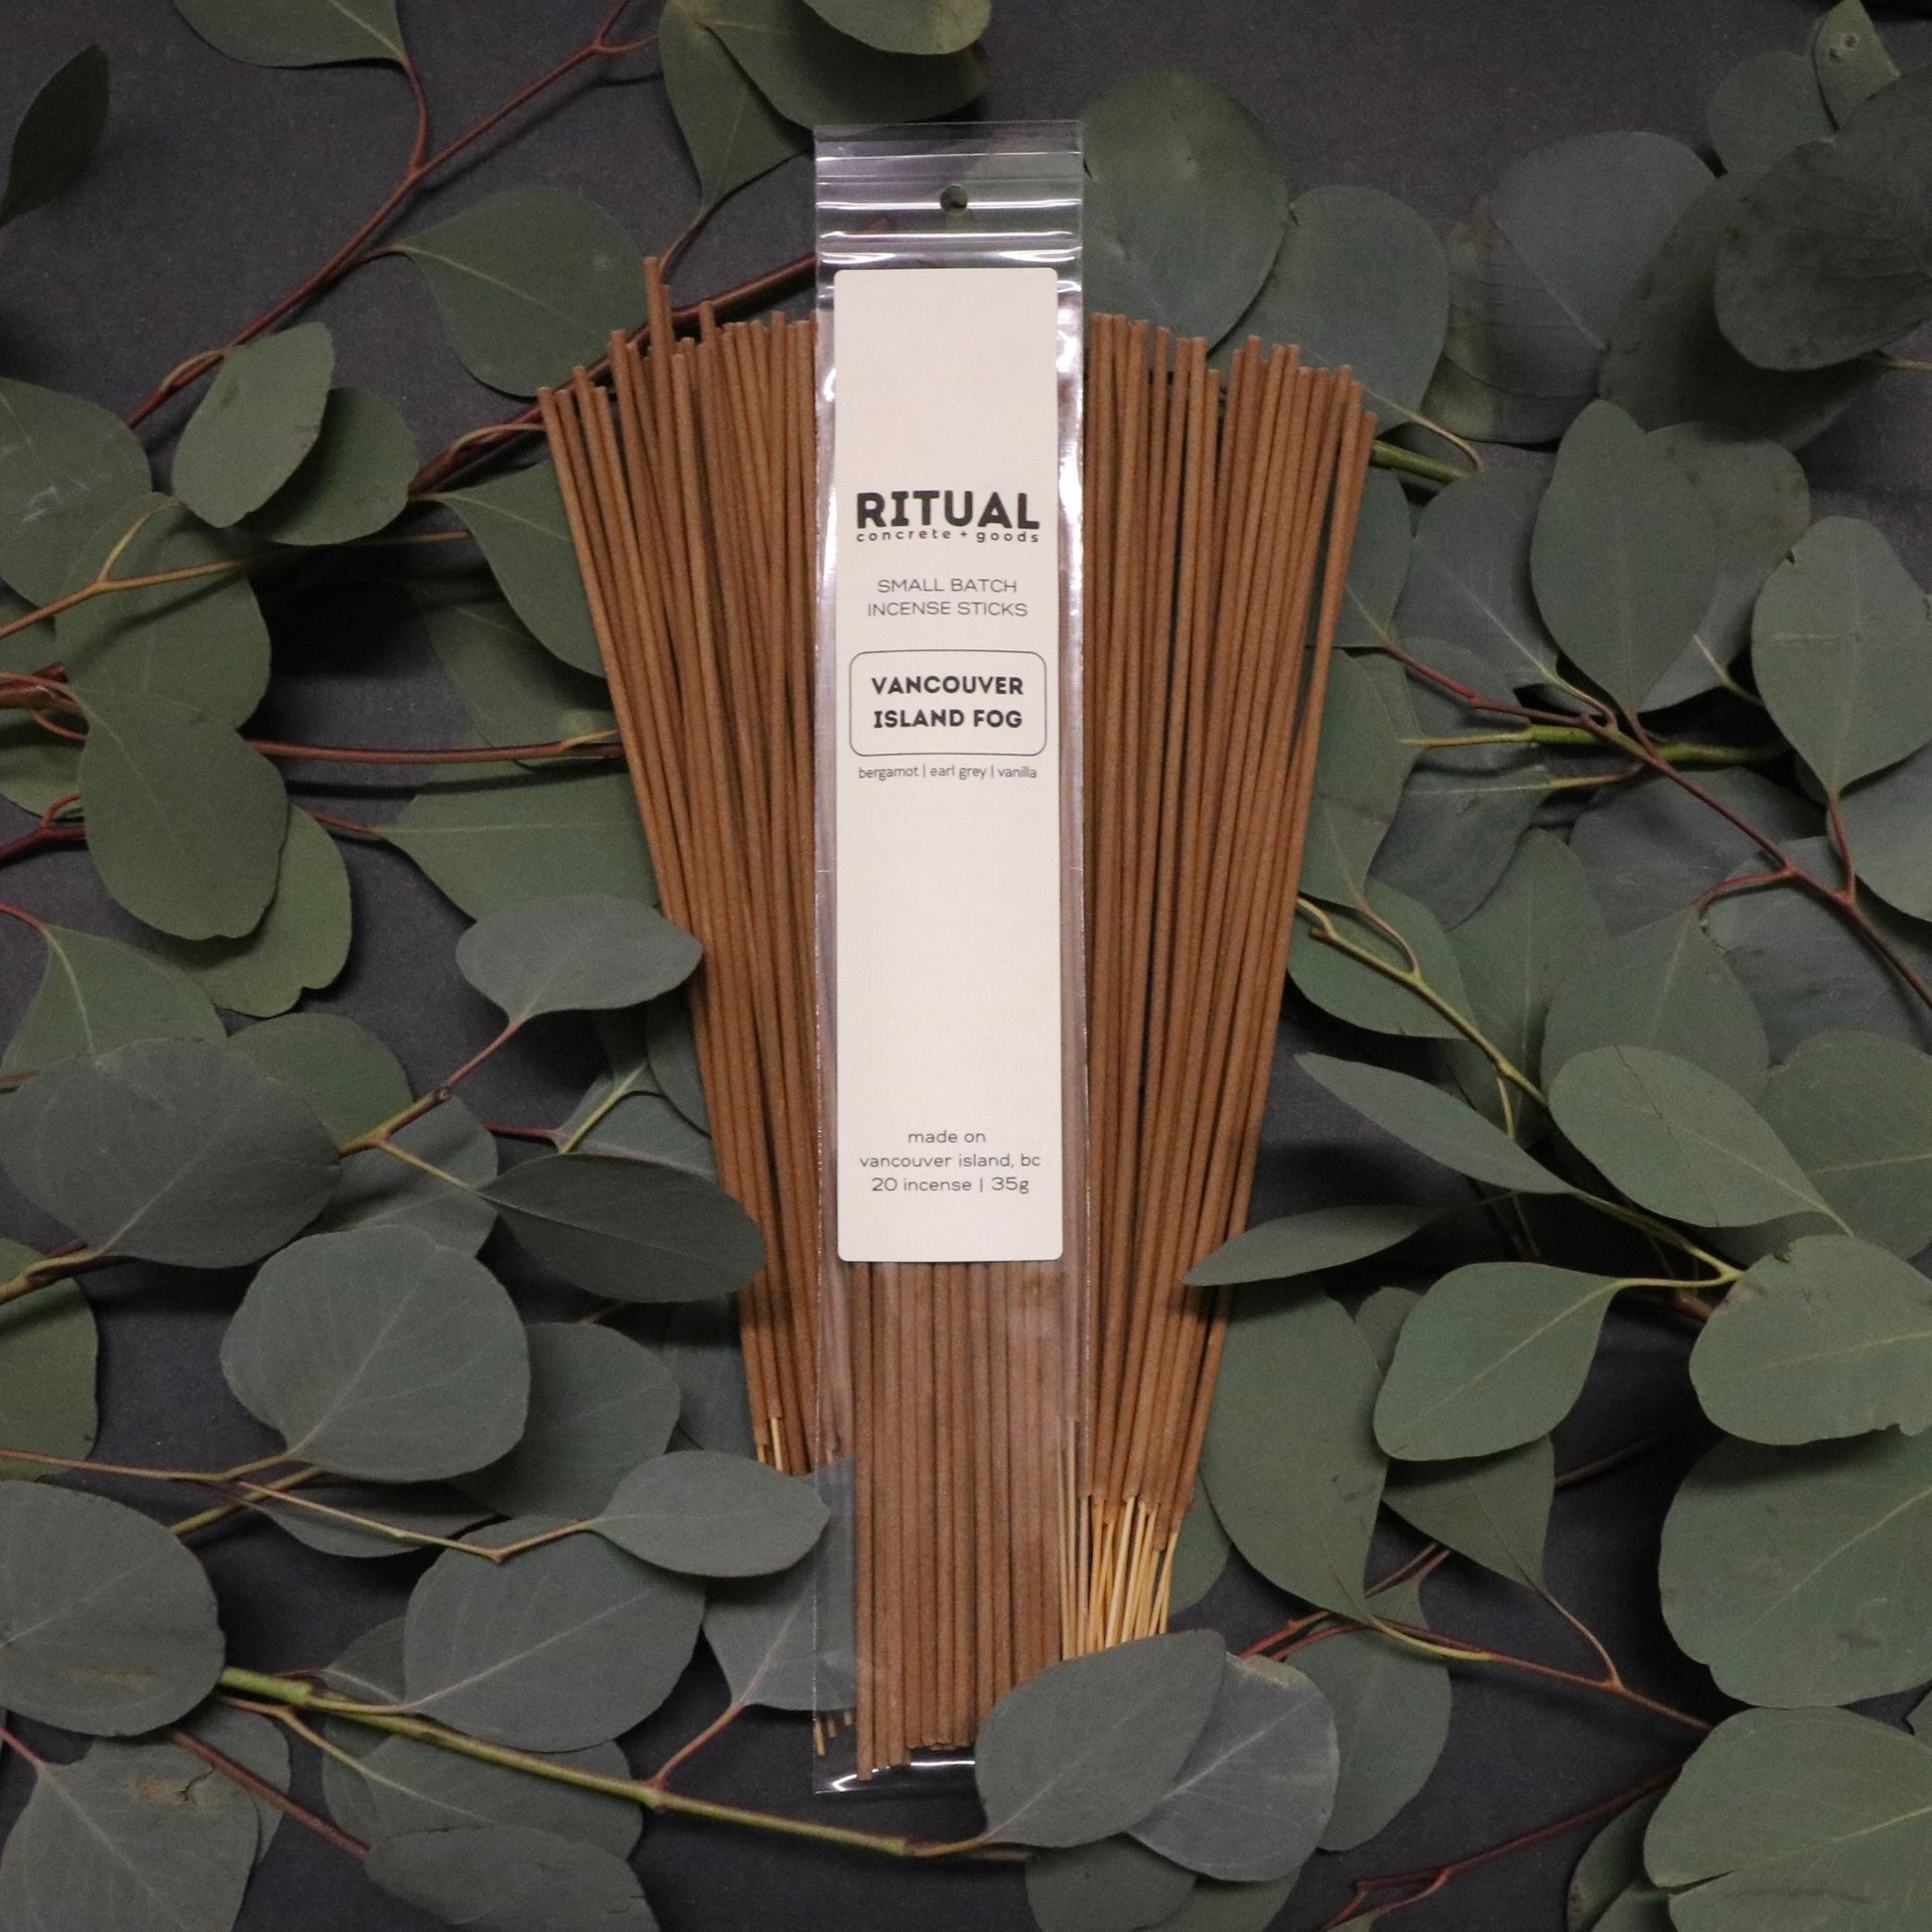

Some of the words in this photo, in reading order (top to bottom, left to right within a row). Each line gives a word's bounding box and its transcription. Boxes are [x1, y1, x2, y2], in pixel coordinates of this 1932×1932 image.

[856, 489, 1040, 529] RITUAL
[856, 529, 951, 542] concrete
[976, 531, 1039, 543] goods
[878, 578, 945, 593] SMALL
[951, 578, 1017, 593] BATCH
[868, 602, 951, 617] INCENSE
[957, 602, 1028, 617] STICKS
[872, 675, 1024, 695] VANCOUVER
[874, 709, 965, 728] ISLAND
[973, 709, 1023, 728] FOG
[858, 766, 919, 780] bergamot
[929, 764, 955, 776] earl
[959, 767, 987, 780] grey
[997, 765, 1036, 778] vanilla
[907, 1130, 958, 1143] made
[964, 1133, 986, 1143] on
[860, 1156, 952, 1168] vancouver
[958, 1154, 1014, 1169] island,
[1021, 1154, 1040, 1167] bc
[872, 1177, 897, 1191] 20
[903, 1177, 972, 1191] incense
[991, 1176, 1030, 1194] 35g
